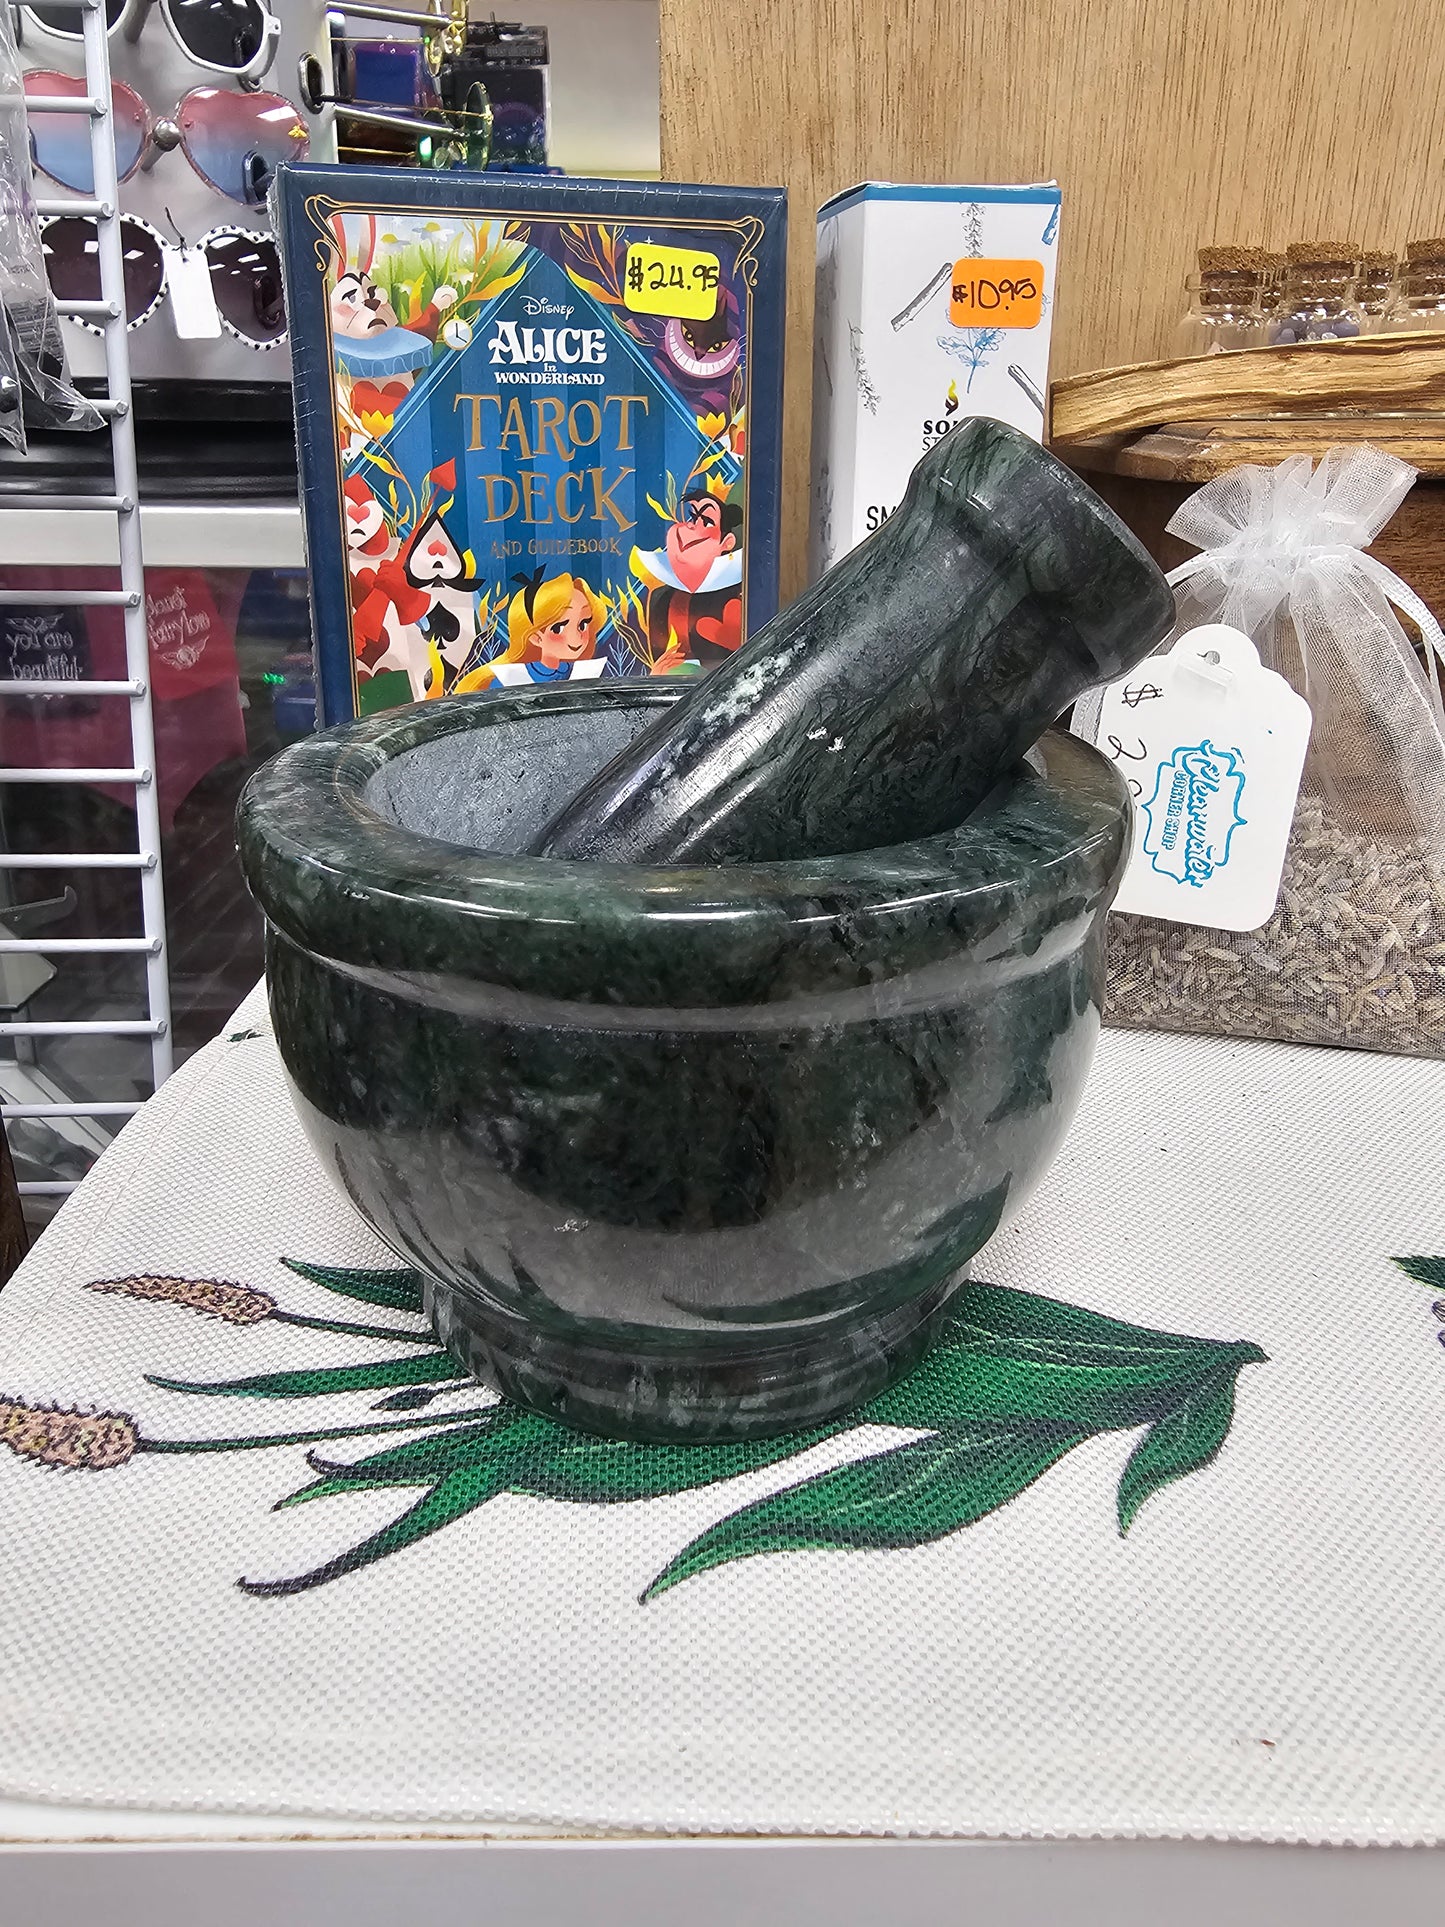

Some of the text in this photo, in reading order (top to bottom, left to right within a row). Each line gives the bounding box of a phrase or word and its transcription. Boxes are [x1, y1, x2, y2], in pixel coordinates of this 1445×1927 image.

[628, 256, 719, 292] $24.95
[952, 278, 1036, 310] $10.95
[487, 320, 608, 365] ALICE
[494, 371, 605, 386] WONDERLAND
[453, 393, 649, 462] TAROT
[477, 466, 639, 533] DECK
[491, 537, 623, 559] AND GUIDEBOOK
[5, 633, 41, 658] you
[1162, 770, 1189, 851] CORNER SHOP
[1181, 752, 1220, 888] Clearwater
